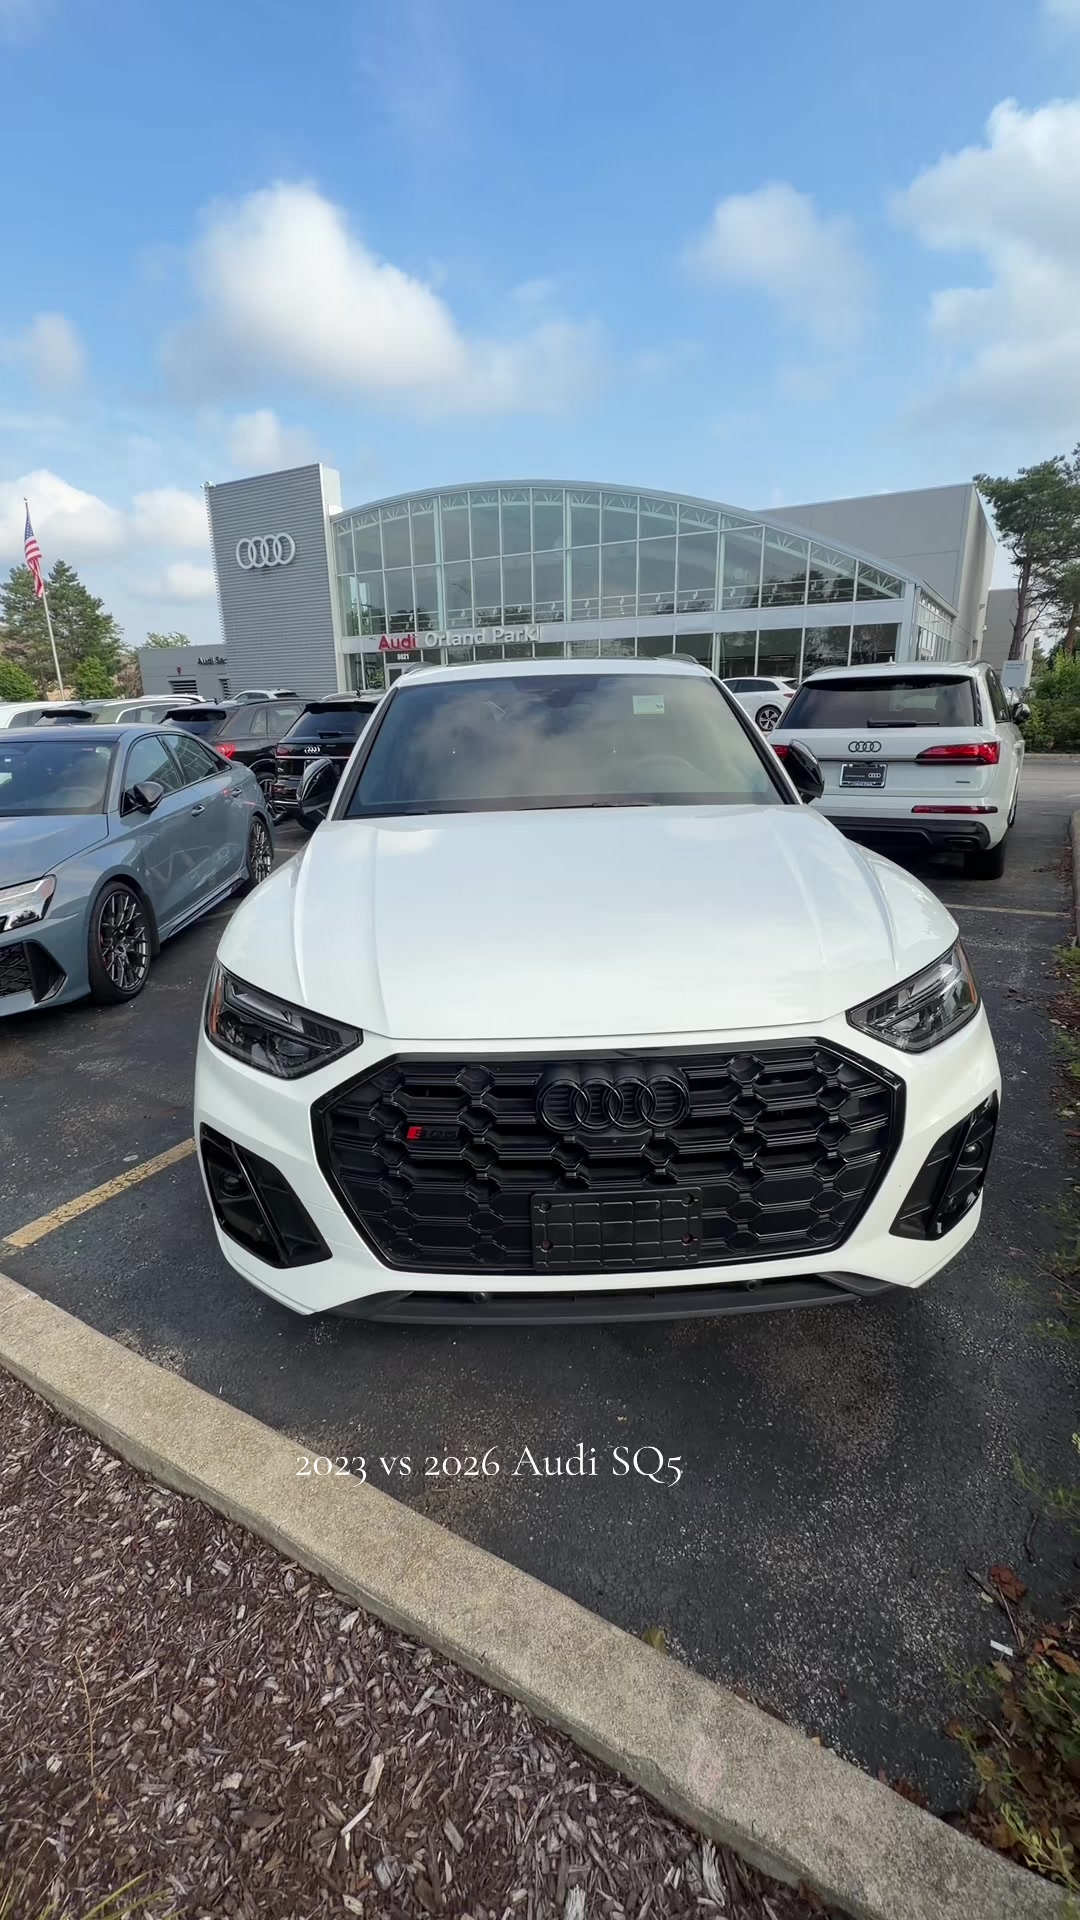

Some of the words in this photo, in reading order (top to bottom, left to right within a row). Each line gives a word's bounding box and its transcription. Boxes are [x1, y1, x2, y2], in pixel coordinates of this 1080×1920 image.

[378, 634, 417, 650] Audi
[424, 628, 486, 648] Orland
[493, 625, 538, 643] Park
[197, 656, 215, 666] Audi
